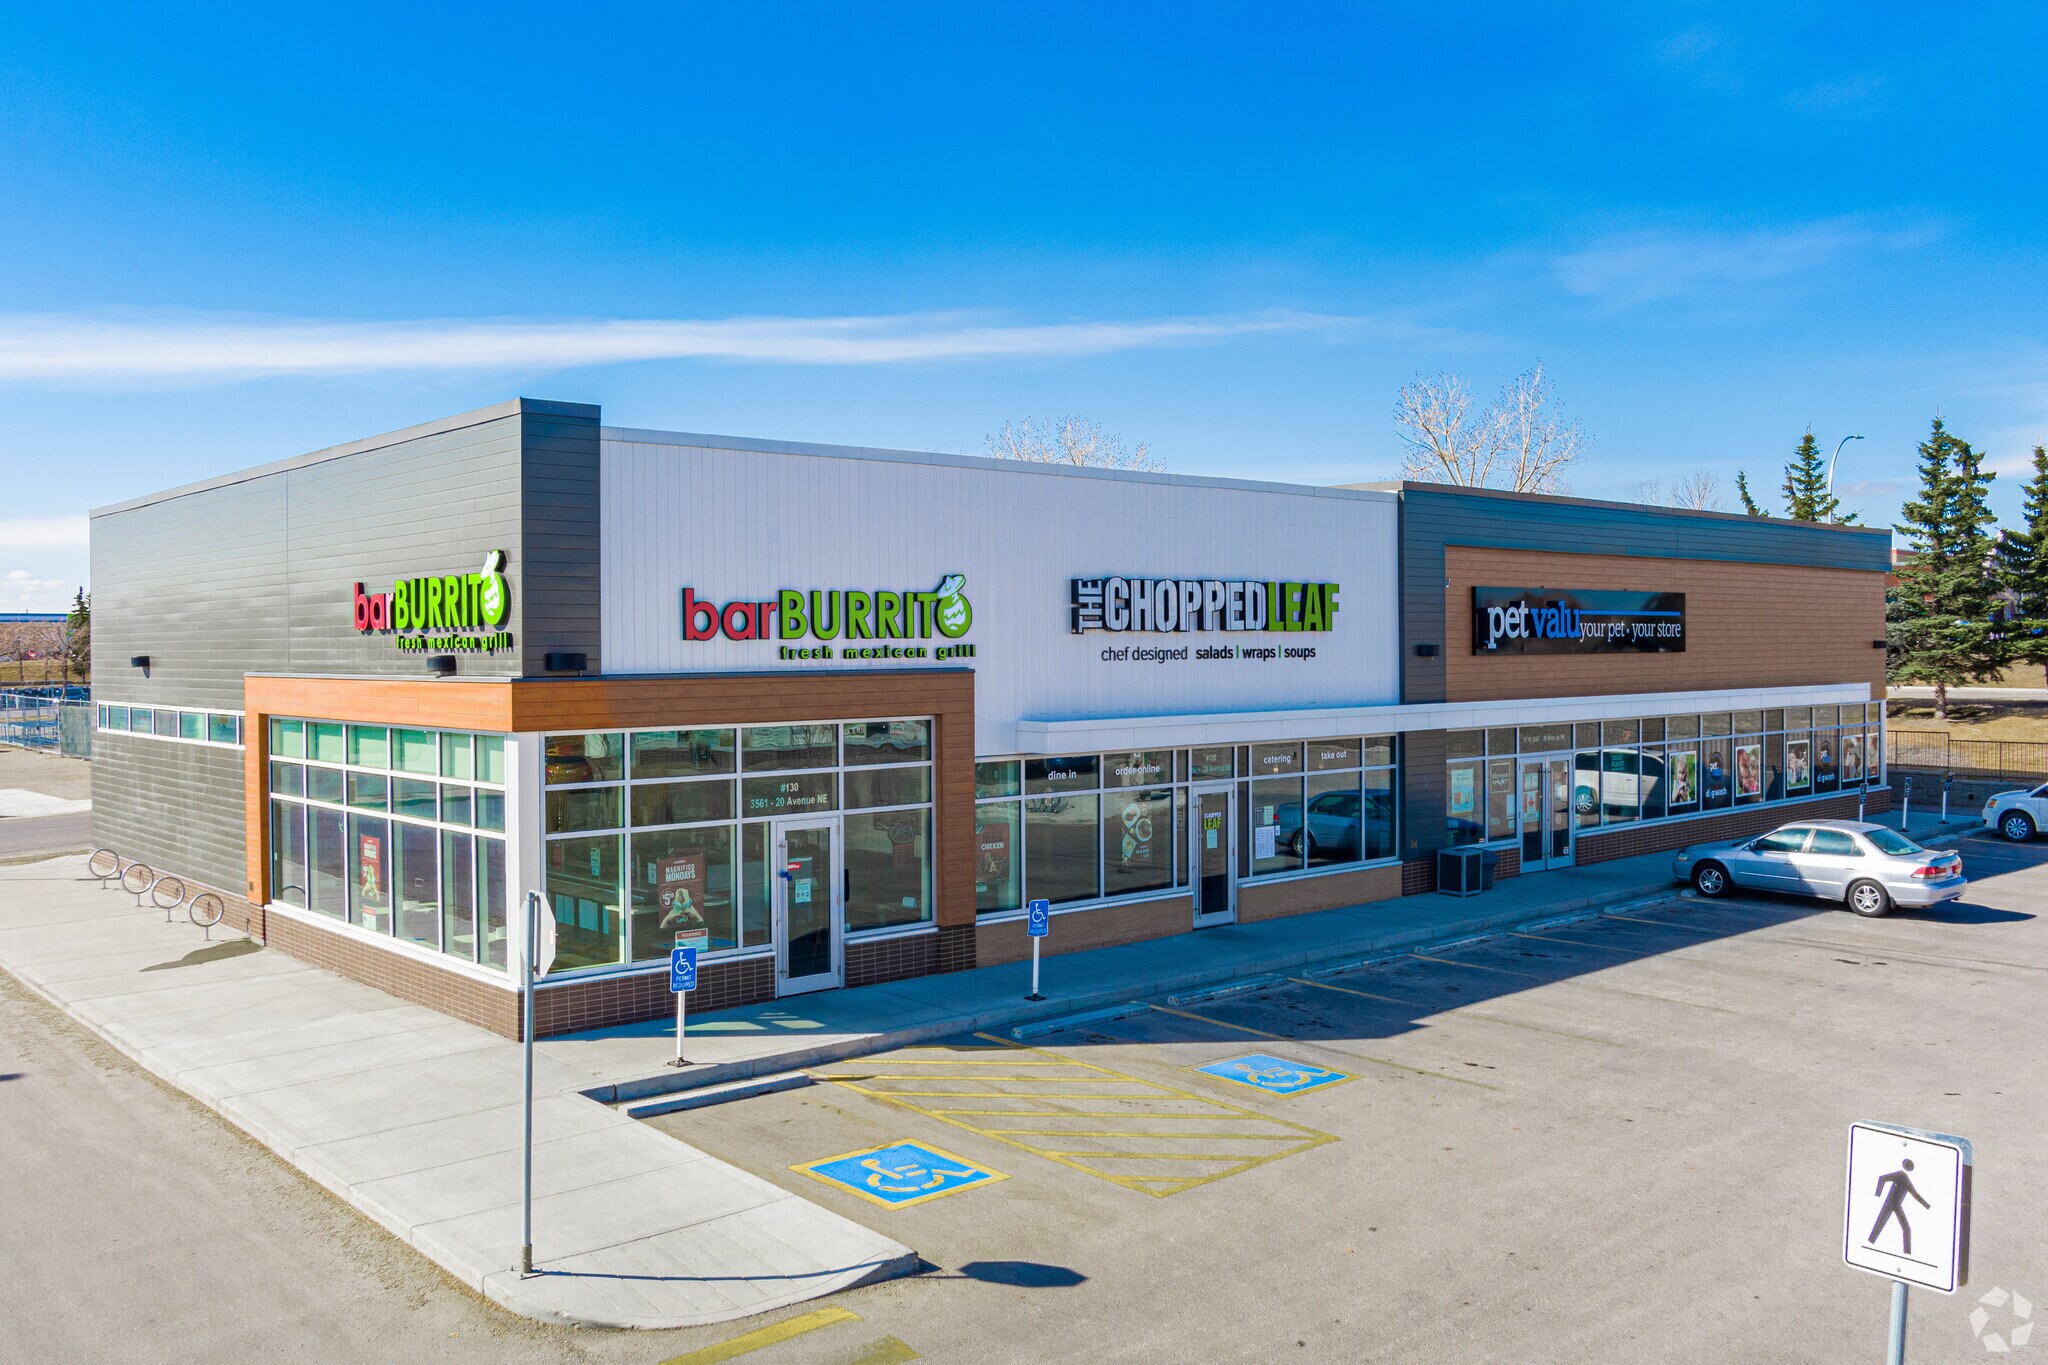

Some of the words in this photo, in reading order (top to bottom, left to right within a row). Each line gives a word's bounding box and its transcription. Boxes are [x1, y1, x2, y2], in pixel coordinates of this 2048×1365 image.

[353, 569, 505, 631] barBURRITO
[1071, 578, 1103, 634] THE
[682, 587, 973, 641] barBURRITO
[1487, 600, 1530, 649] pet
[1530, 600, 1581, 638] valu
[1579, 622, 1606, 643] your
[1607, 621, 1626, 642] pet
[1631, 622, 1656, 643] your
[1657, 623, 1682, 638] store
[395, 635, 424, 650] fresh
[428, 633, 475, 649] mexican
[481, 632, 508, 652] grill
[778, 645, 834, 660] fresh
[842, 645, 928, 660] mexican
[935, 644, 977, 661] grill
[1100, 646, 1130, 662] chef
[1131, 646, 1189, 664] designed
[1195, 645, 1234, 660] salads
[1242, 647, 1277, 660] wraps
[1283, 646, 1317, 659] soups
[1263, 754, 1292, 765] catering
[1320, 750, 1335, 760] take
[1336, 750, 1347, 759] out
[1048, 770, 1066, 780] dine
[1068, 770, 1077, 779] in
[1114, 767, 1136, 776] order
[1137, 764, 1161, 774] online
[780, 782, 799, 793] #130
[750, 798, 768, 809] 3561
[775, 797, 785, 807] 20
[786, 795, 816, 806] Avenue
[817, 793, 828, 804] NE
[1203, 817, 1222, 830] LEAF
[981, 842, 1005, 850] CHICKEN
[665, 869, 696, 882] MONDAYS
[672, 981, 695, 989] REQUIRED
